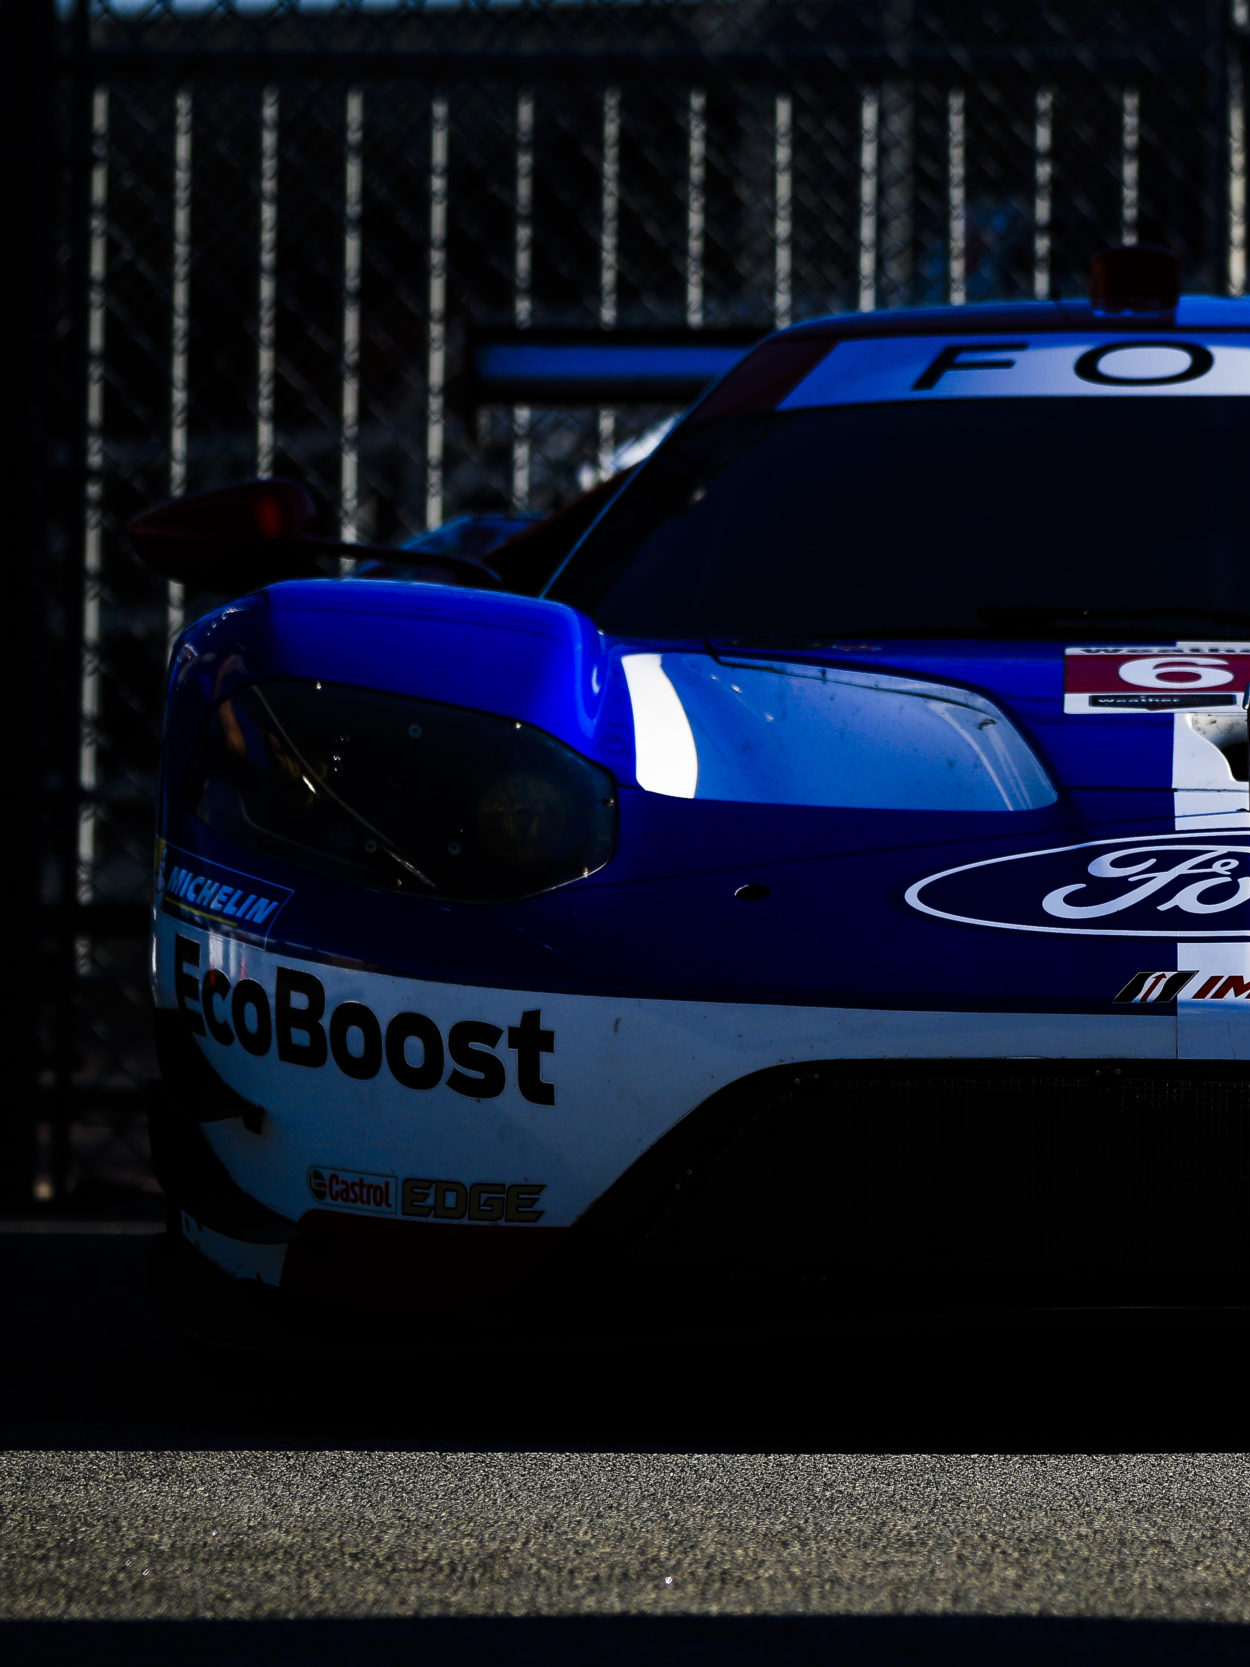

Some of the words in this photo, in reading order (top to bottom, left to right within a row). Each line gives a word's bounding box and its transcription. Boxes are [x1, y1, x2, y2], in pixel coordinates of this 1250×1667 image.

[167, 864, 280, 924] MICHELIN
[175, 934, 556, 1106] EcoBoost
[328, 1173, 393, 1209] Castrol
[401, 1178, 546, 1223] EDGE
